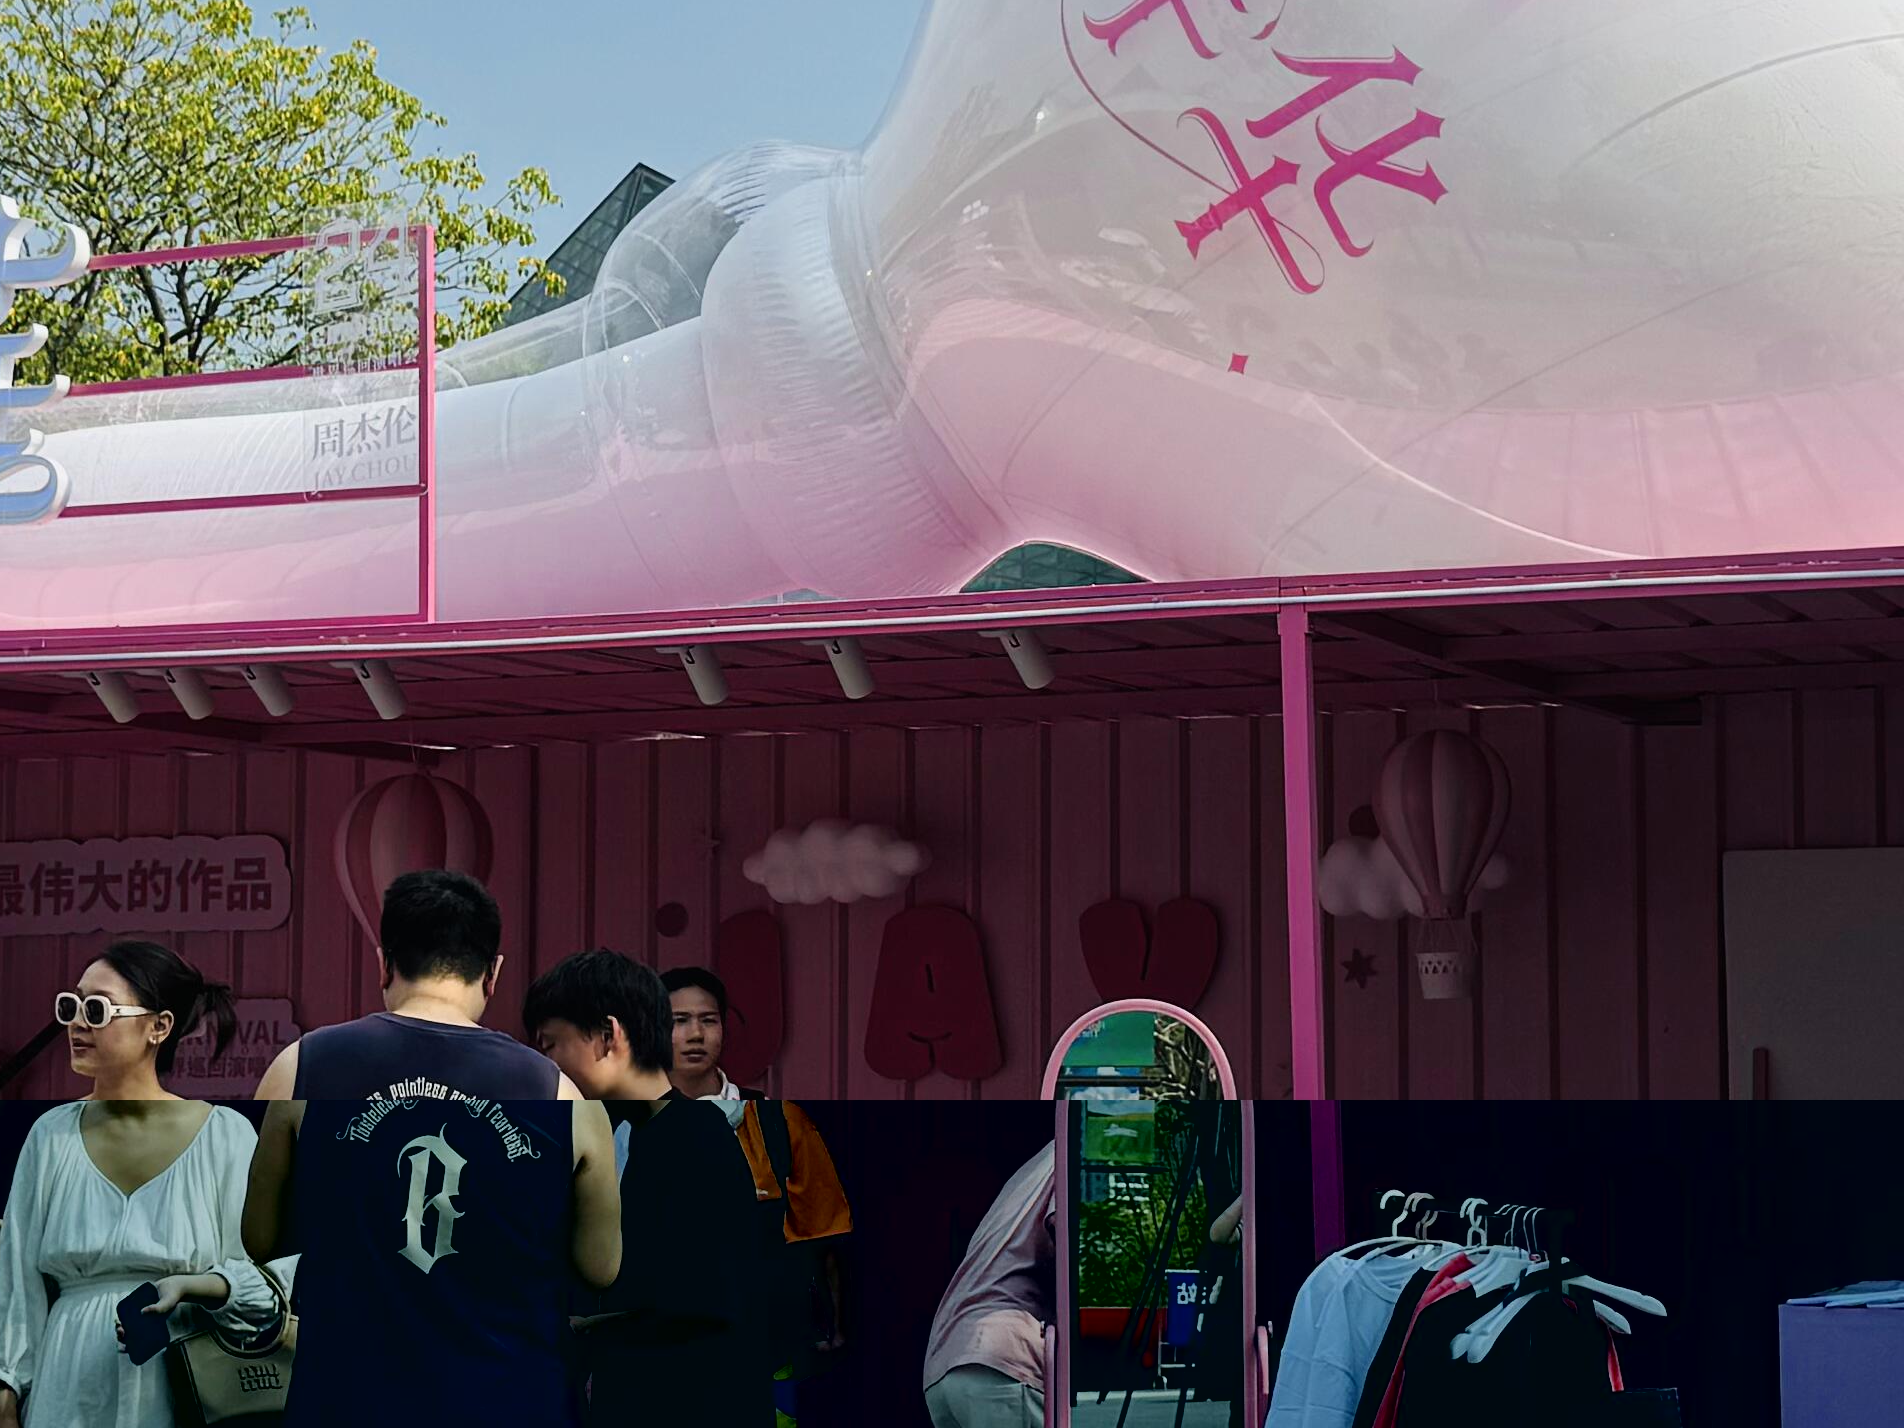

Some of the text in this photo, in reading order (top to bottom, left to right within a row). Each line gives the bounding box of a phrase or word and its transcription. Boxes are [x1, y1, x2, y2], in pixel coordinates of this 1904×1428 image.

[312, 405, 417, 461] 周杰伦
[313, 453, 417, 494] JAY CHOU
